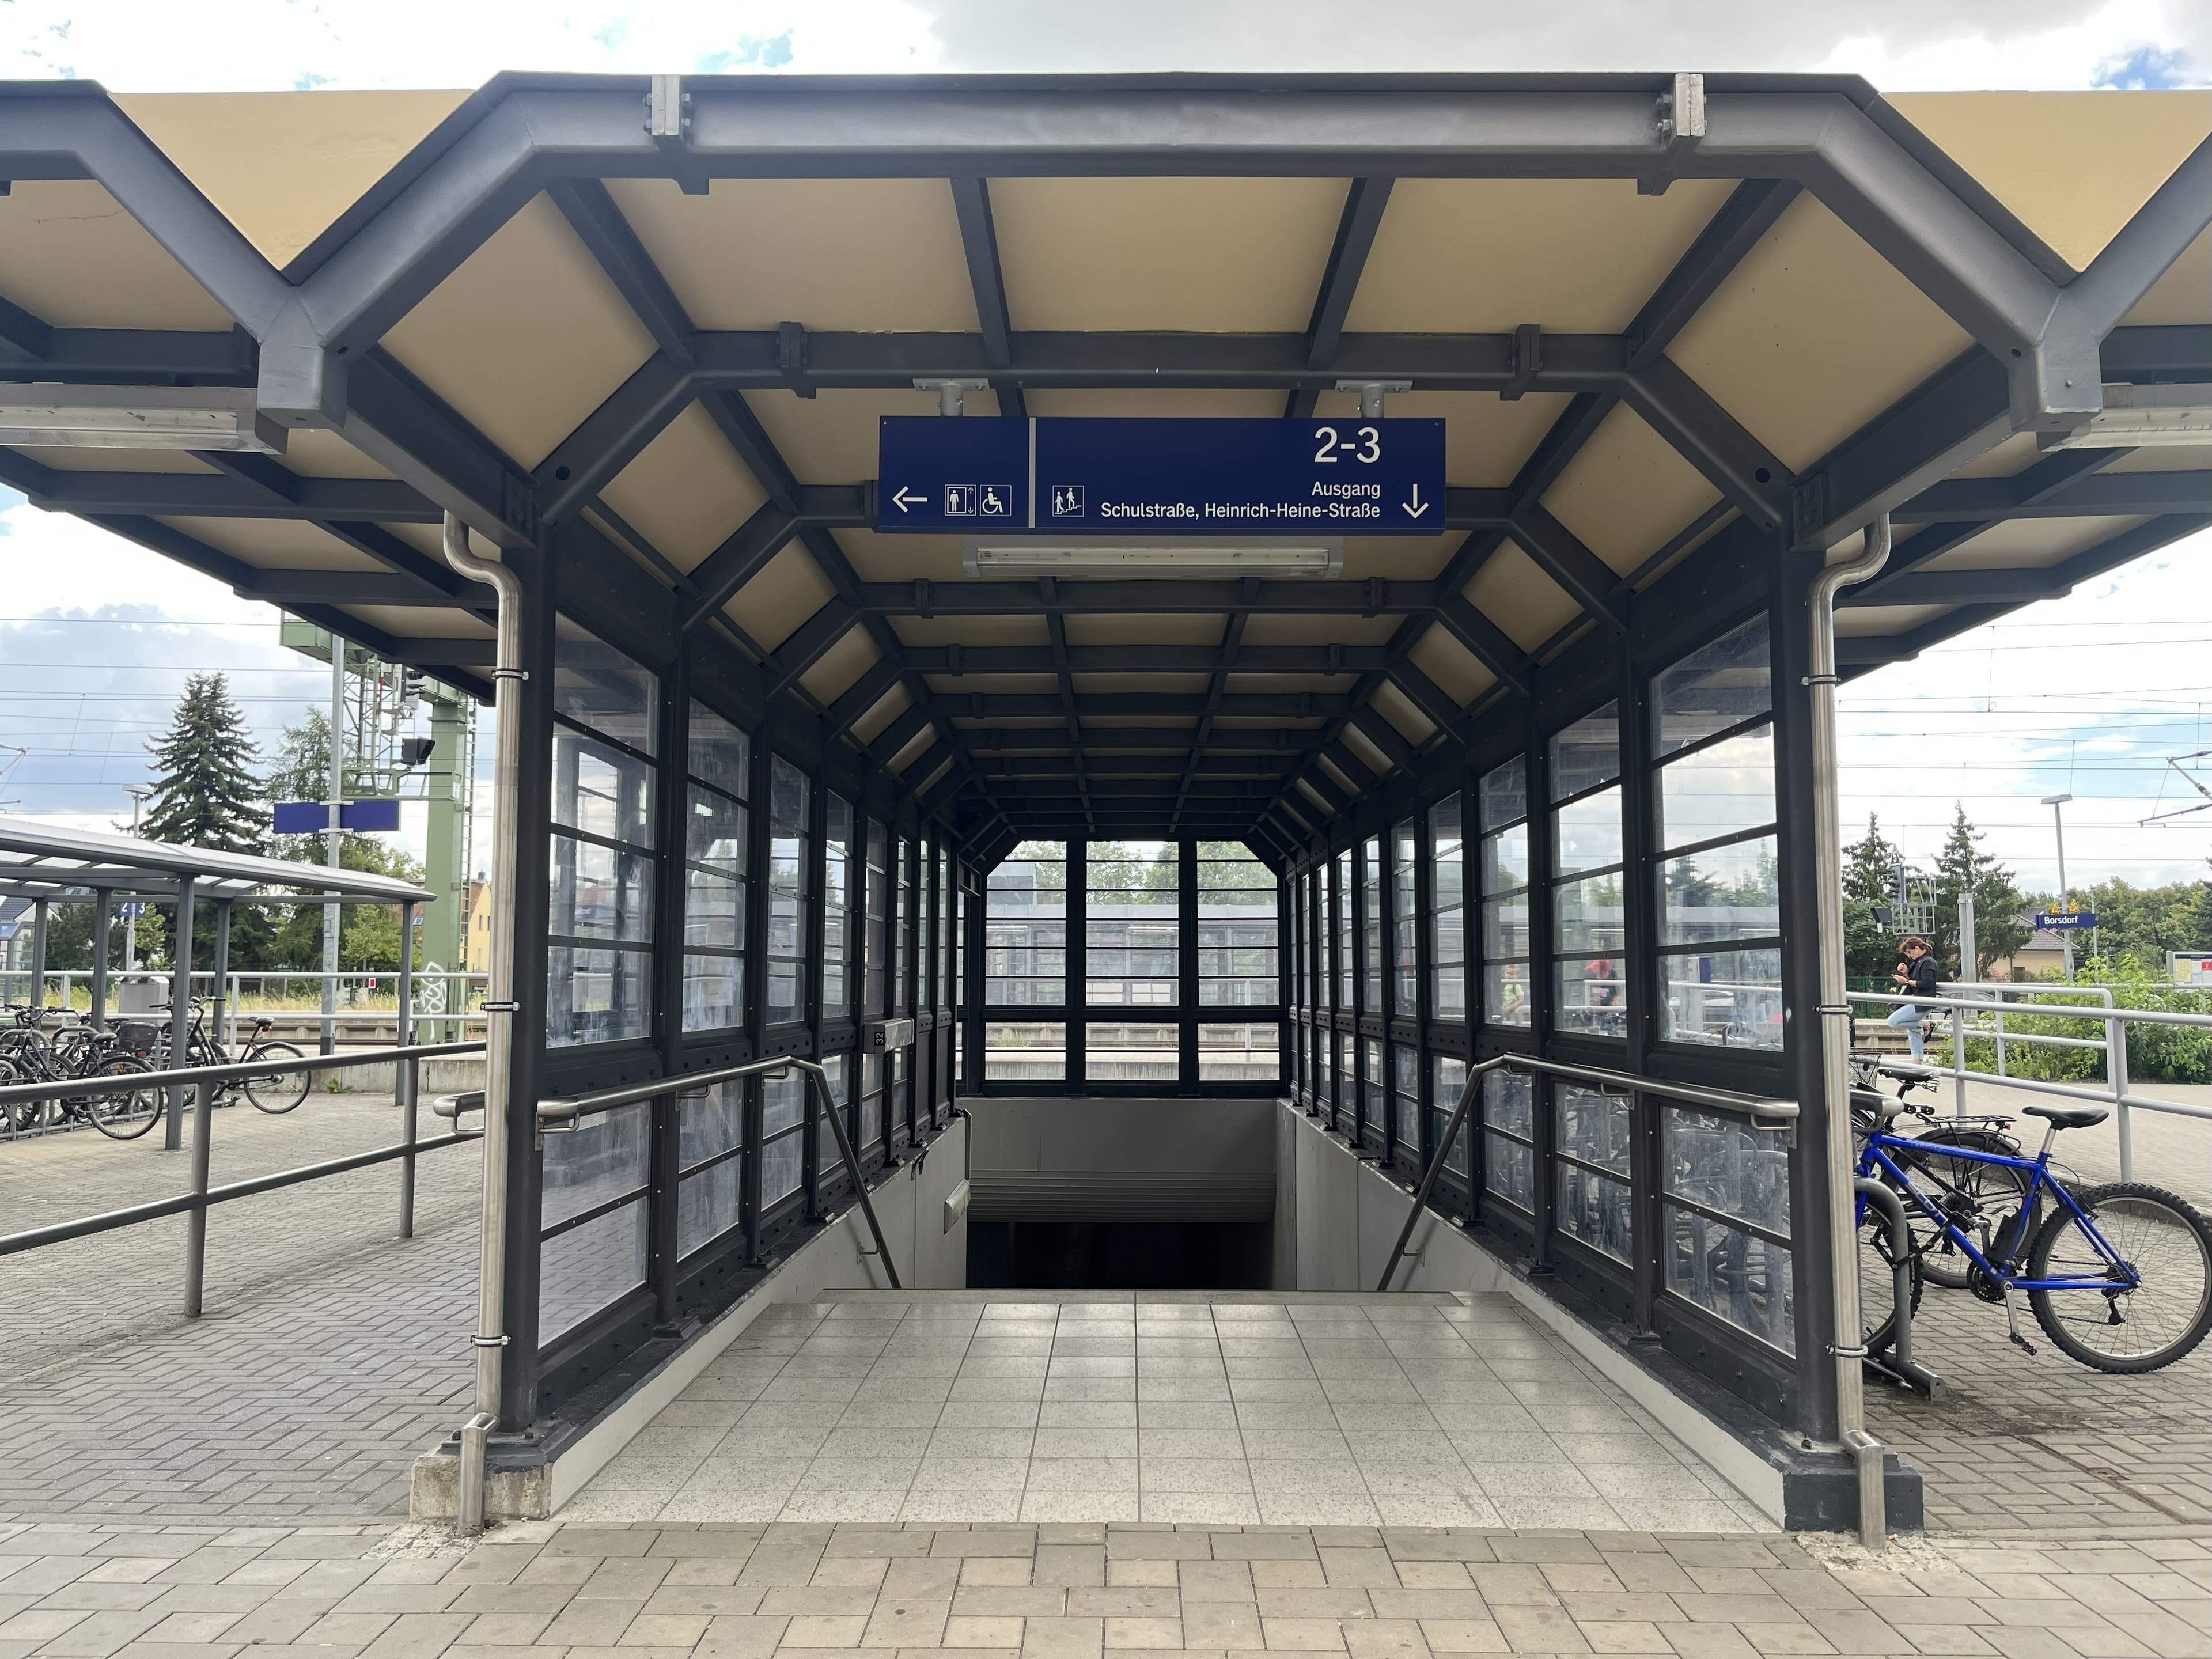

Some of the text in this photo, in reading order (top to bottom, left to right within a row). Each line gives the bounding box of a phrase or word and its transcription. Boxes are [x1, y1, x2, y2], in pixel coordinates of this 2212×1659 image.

[1314, 427, 1380, 463] 2-3
[1311, 481, 1380, 500] Ausgang
[1101, 503, 1380, 520] Schulstraße, Heinrich-Heine-Straße
[139, 902, 145, 914] 3
[2044, 915, 2078, 925] Borsdorf
[876, 1032, 884, 1044] 32
